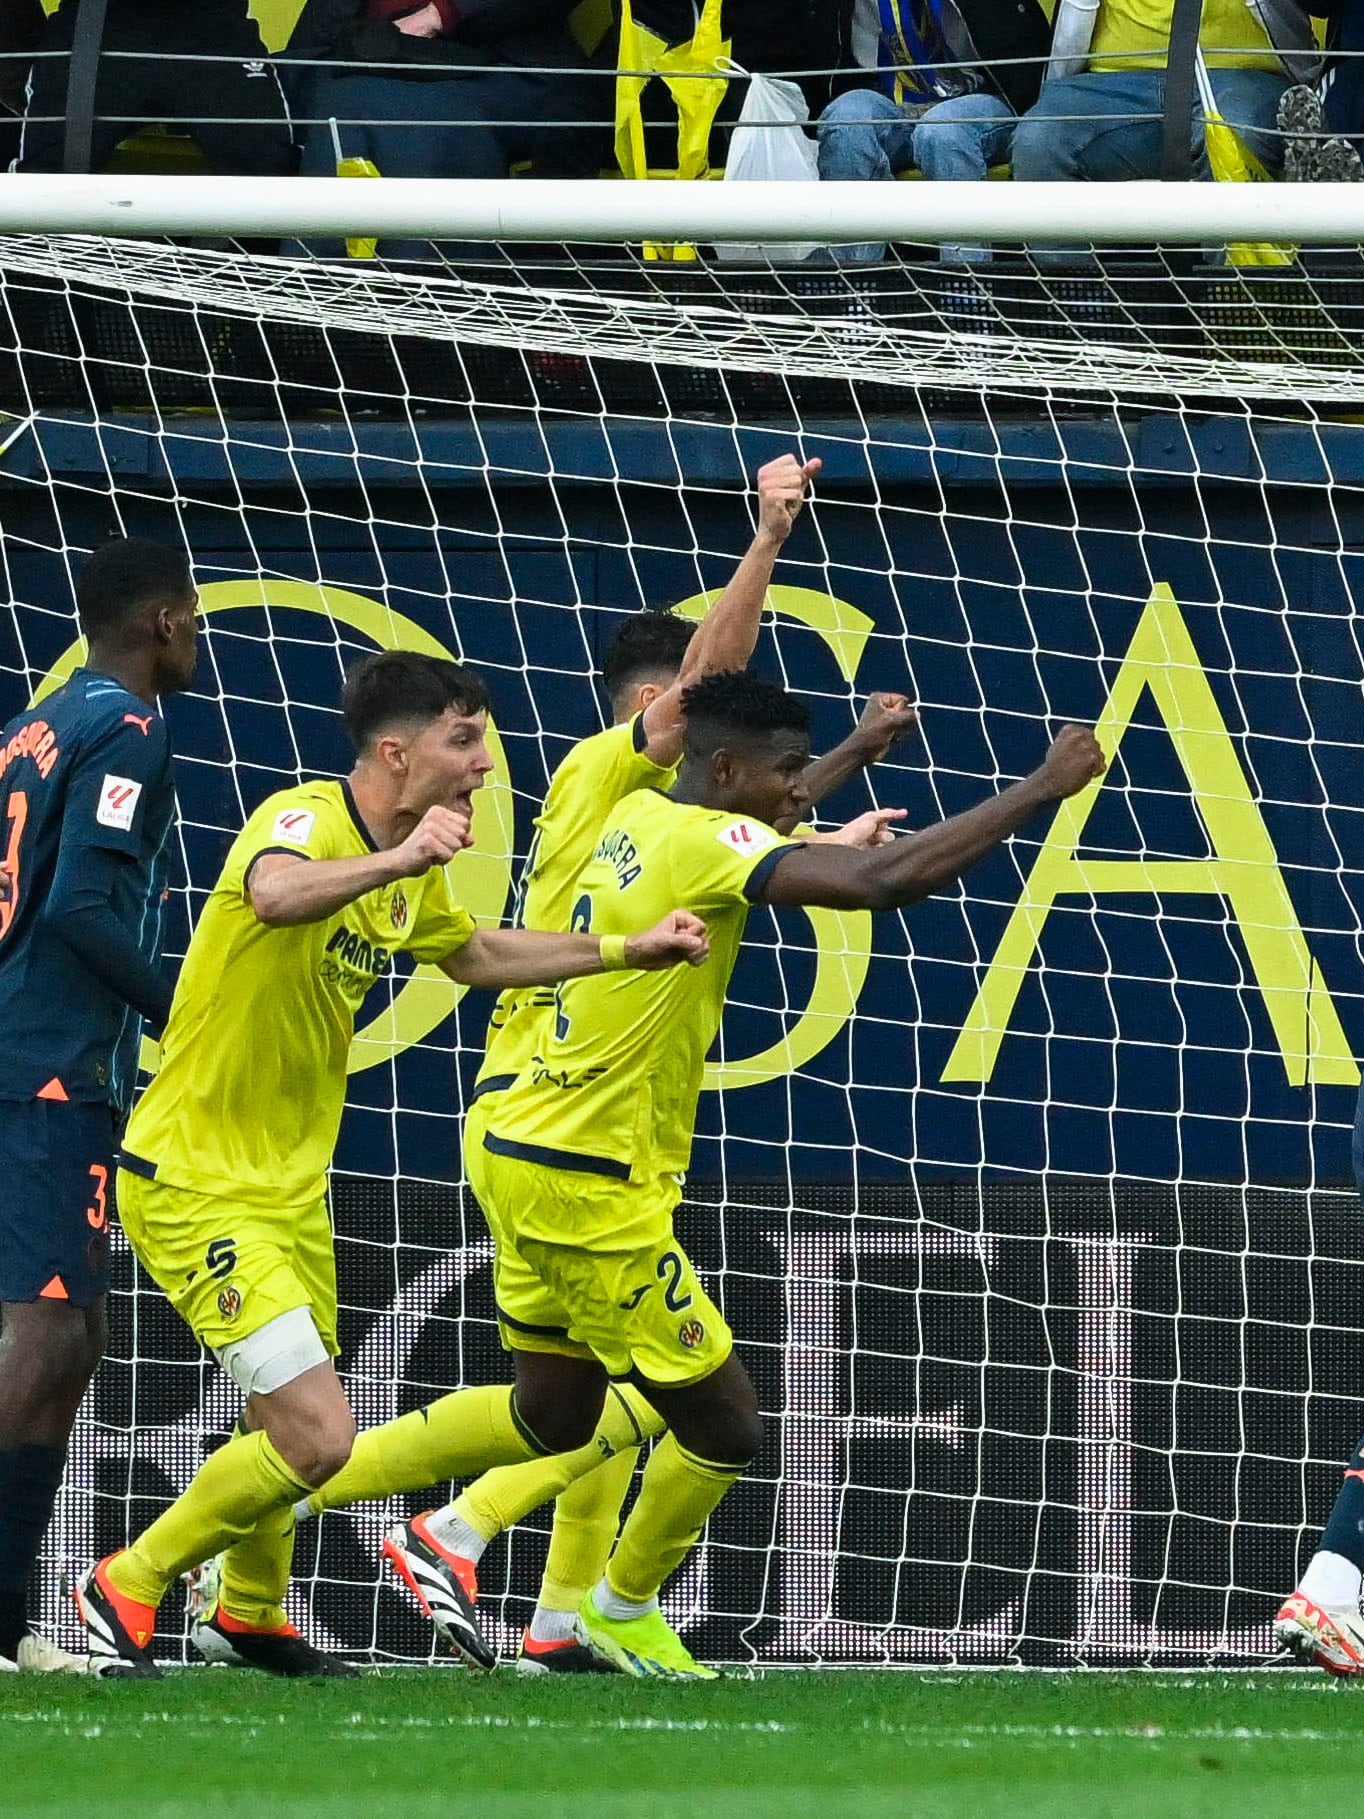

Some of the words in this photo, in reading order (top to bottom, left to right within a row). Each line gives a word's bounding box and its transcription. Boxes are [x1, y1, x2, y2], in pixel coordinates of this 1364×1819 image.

[87, 1164, 108, 1229] 3
[205, 1237, 238, 1280] 5
[656, 1251, 693, 1314] 2
